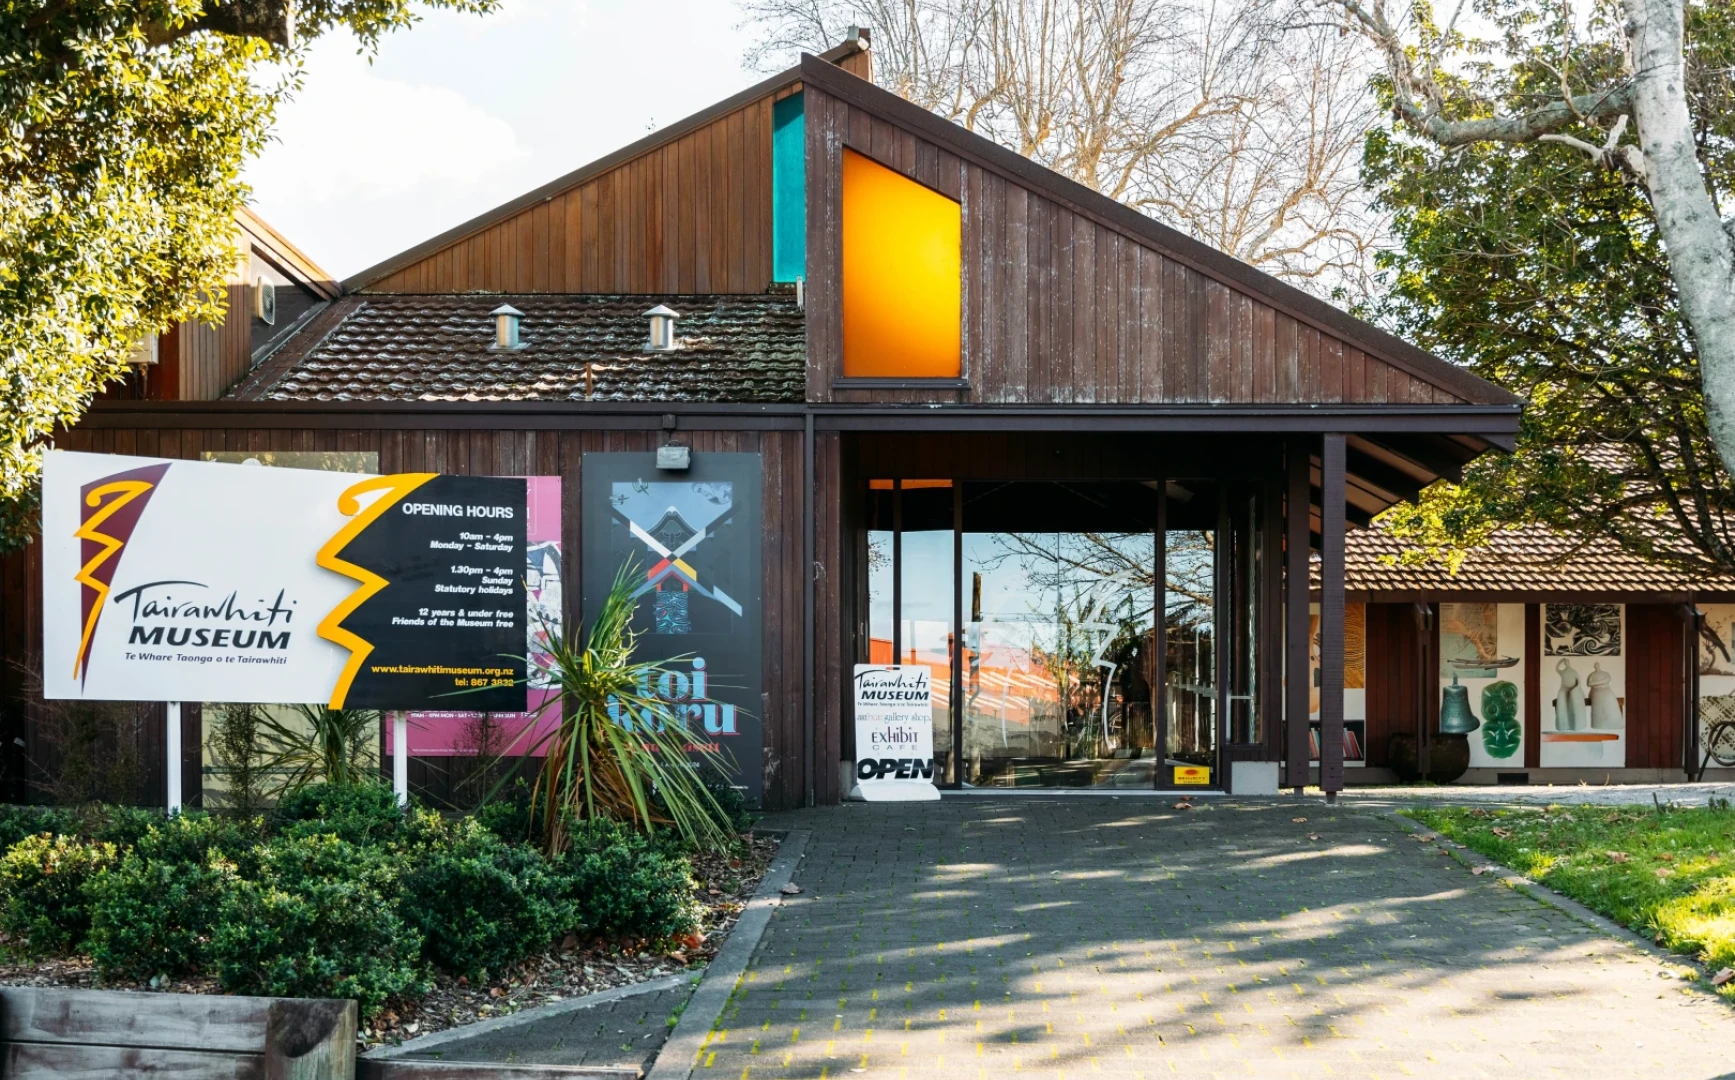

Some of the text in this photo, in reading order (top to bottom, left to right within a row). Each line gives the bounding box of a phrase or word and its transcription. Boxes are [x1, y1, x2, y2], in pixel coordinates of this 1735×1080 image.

[402, 502, 514, 518] OPENING HOURS
[459, 532, 483, 540] 10am
[493, 533, 513, 542] 4pm
[430, 540, 464, 551] Monday
[474, 542, 513, 552] Saturday
[450, 566, 483, 575] 1.30pm
[493, 566, 513, 576] 4pm
[482, 576, 513, 586] Sunday
[434, 584, 514, 596] Statutory holidays
[114, 580, 298, 626] Tairawhiti
[418, 608, 514, 618] 12 years & under free
[392, 617, 514, 628] Friends of the Museum free
[128, 626, 292, 650] MUSEUM
[125, 652, 136, 660] Te
[138, 652, 172, 662] Whare
[176, 654, 212, 664] Taonga
[238, 656, 287, 664] Tairawhiti
[371, 664, 514, 676] www.tairawhitimuseum.org.nz
[454, 678, 468, 686] tel:
[470, 678, 488, 686] 867
[633, 656, 709, 702] toi
[854, 669, 930, 690] Tairawhiti
[860, 690, 930, 700] MUSEUM
[857, 758, 934, 780] OPEN
